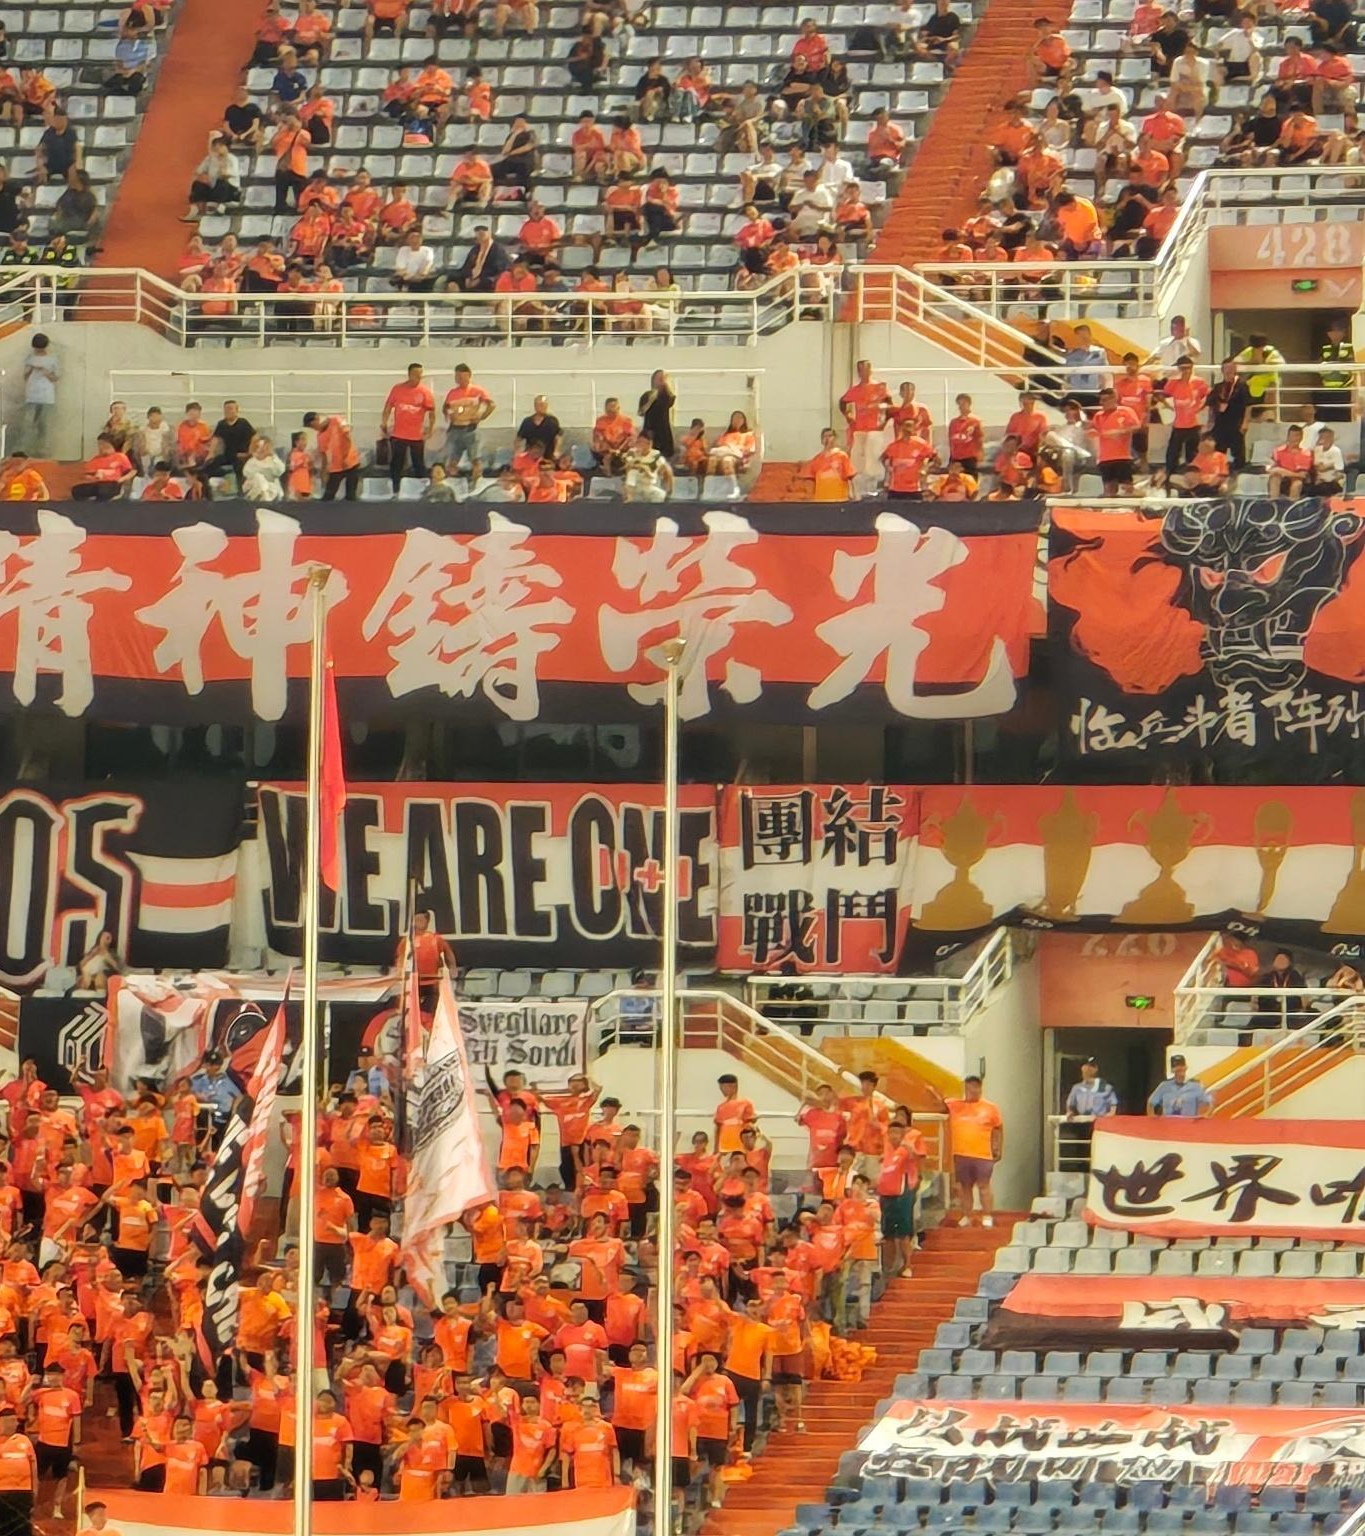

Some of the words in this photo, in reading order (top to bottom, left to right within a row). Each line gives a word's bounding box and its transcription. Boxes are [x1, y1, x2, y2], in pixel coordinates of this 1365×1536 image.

[1256, 224, 1351, 267] 428
[399, 796, 559, 942] ARE
[569, 792, 717, 947] ONE
